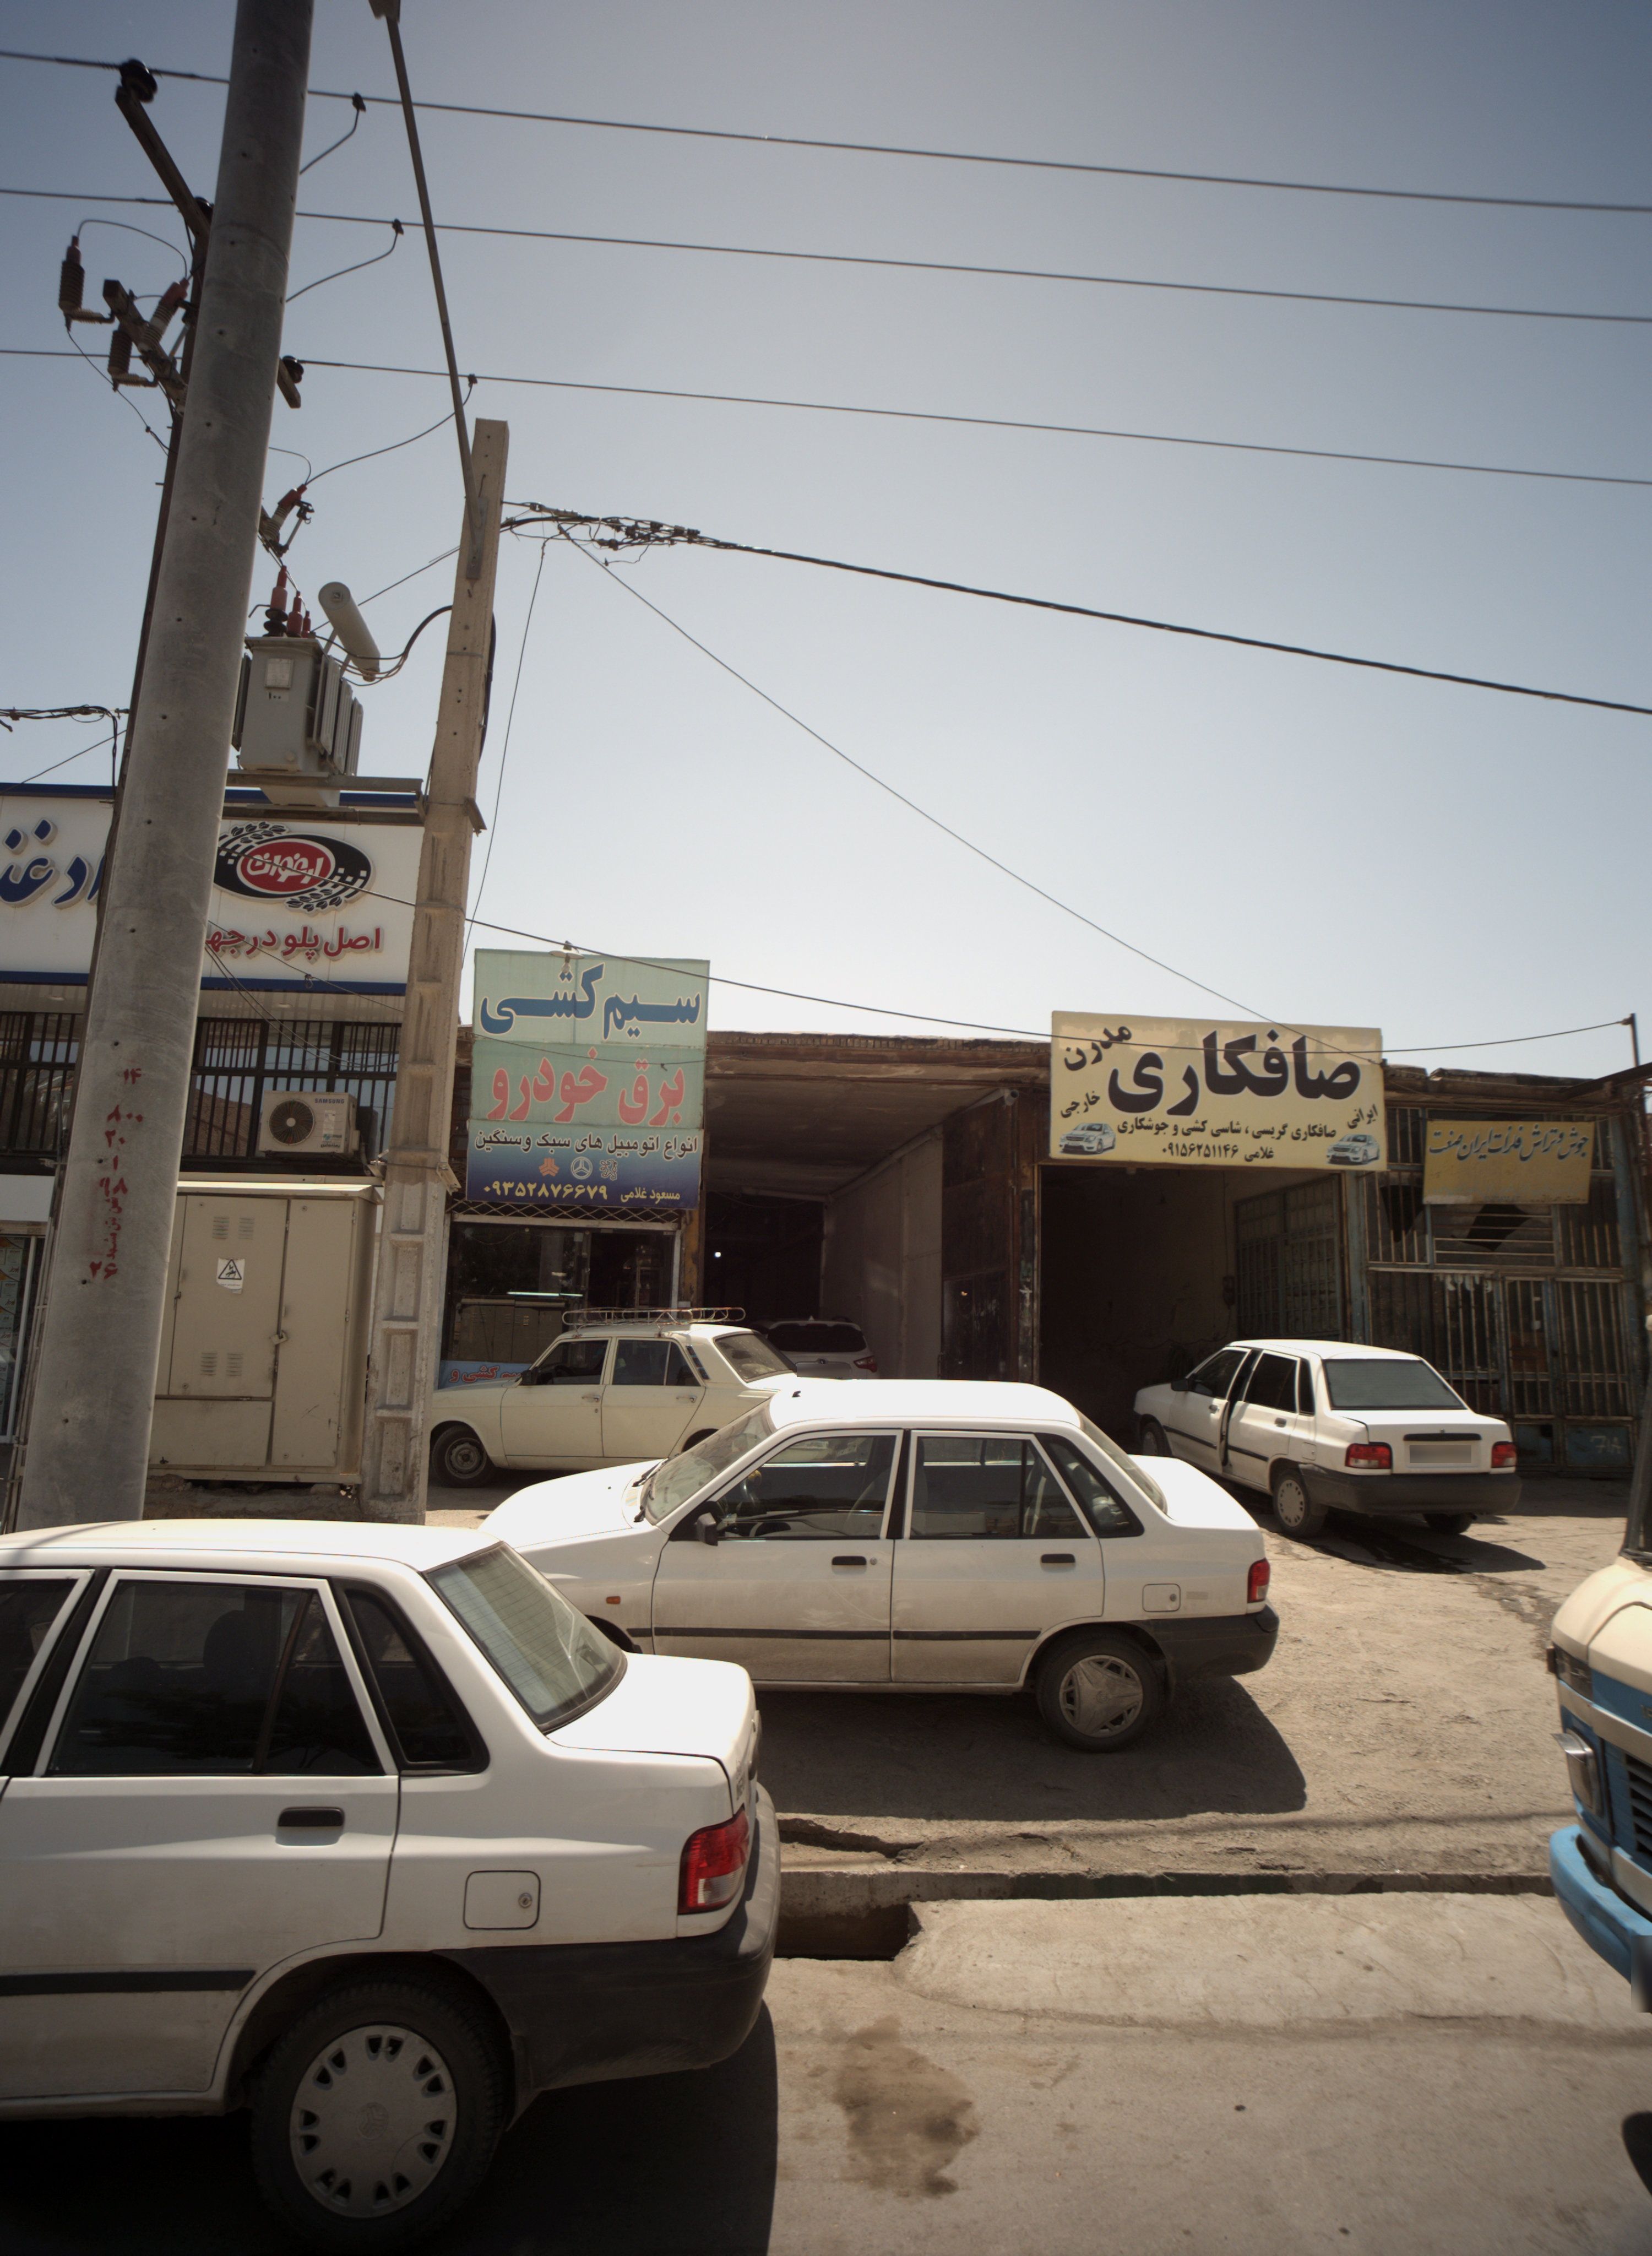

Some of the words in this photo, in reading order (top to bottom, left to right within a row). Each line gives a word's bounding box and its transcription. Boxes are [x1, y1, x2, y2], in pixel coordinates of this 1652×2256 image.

[247, 852, 324, 884] ارغوان
[282, 926, 319, 961] پلو
[323, 926, 380, 957] اصل
[480, 963, 605, 1034] کشی
[604, 993, 700, 1039] سیم
[1064, 1026, 1132, 1071] مدرن
[1108, 1029, 1361, 1116] صافکاری
[486, 1047, 607, 1123] خودرو
[618, 1059, 684, 1126] برق
[1061, 1091, 1100, 1118] خارجی
[1117, 1116, 1169, 1135] جوشکاری
[1182, 1119, 1208, 1136] کشی
[1347, 1104, 1378, 1129] ایرانی
[1172, 1124, 1178, 1136] و
[1211, 1121, 1242, 1137] شاسی
[1291, 1123, 1336, 1141] صافکاری
[1488, 1125, 1524, 1154] فلزات
[536, 1133, 570, 1153] سبک
[575, 1134, 602, 1152] های
[607, 1134, 660, 1156] اتومبیل
[664, 1136, 697, 1160] انواع
[1162, 1142, 1238, 1158] ۰۹۱۵۶۲۵۱۱۴۶
[1429, 1130, 1463, 1153] صنعت
[1457, 1127, 1493, 1161] ایران
[1244, 1146, 1274, 1162] غلامی
[484, 1180, 608, 1200] ۰۹۳۵۲۸۷۶۶۷۹
[621, 1187, 647, 1203] غلامی
[649, 1190, 680, 1204] مسعود
[449, 1369, 459, 1382] و
[463, 1365, 499, 1382] کشی
